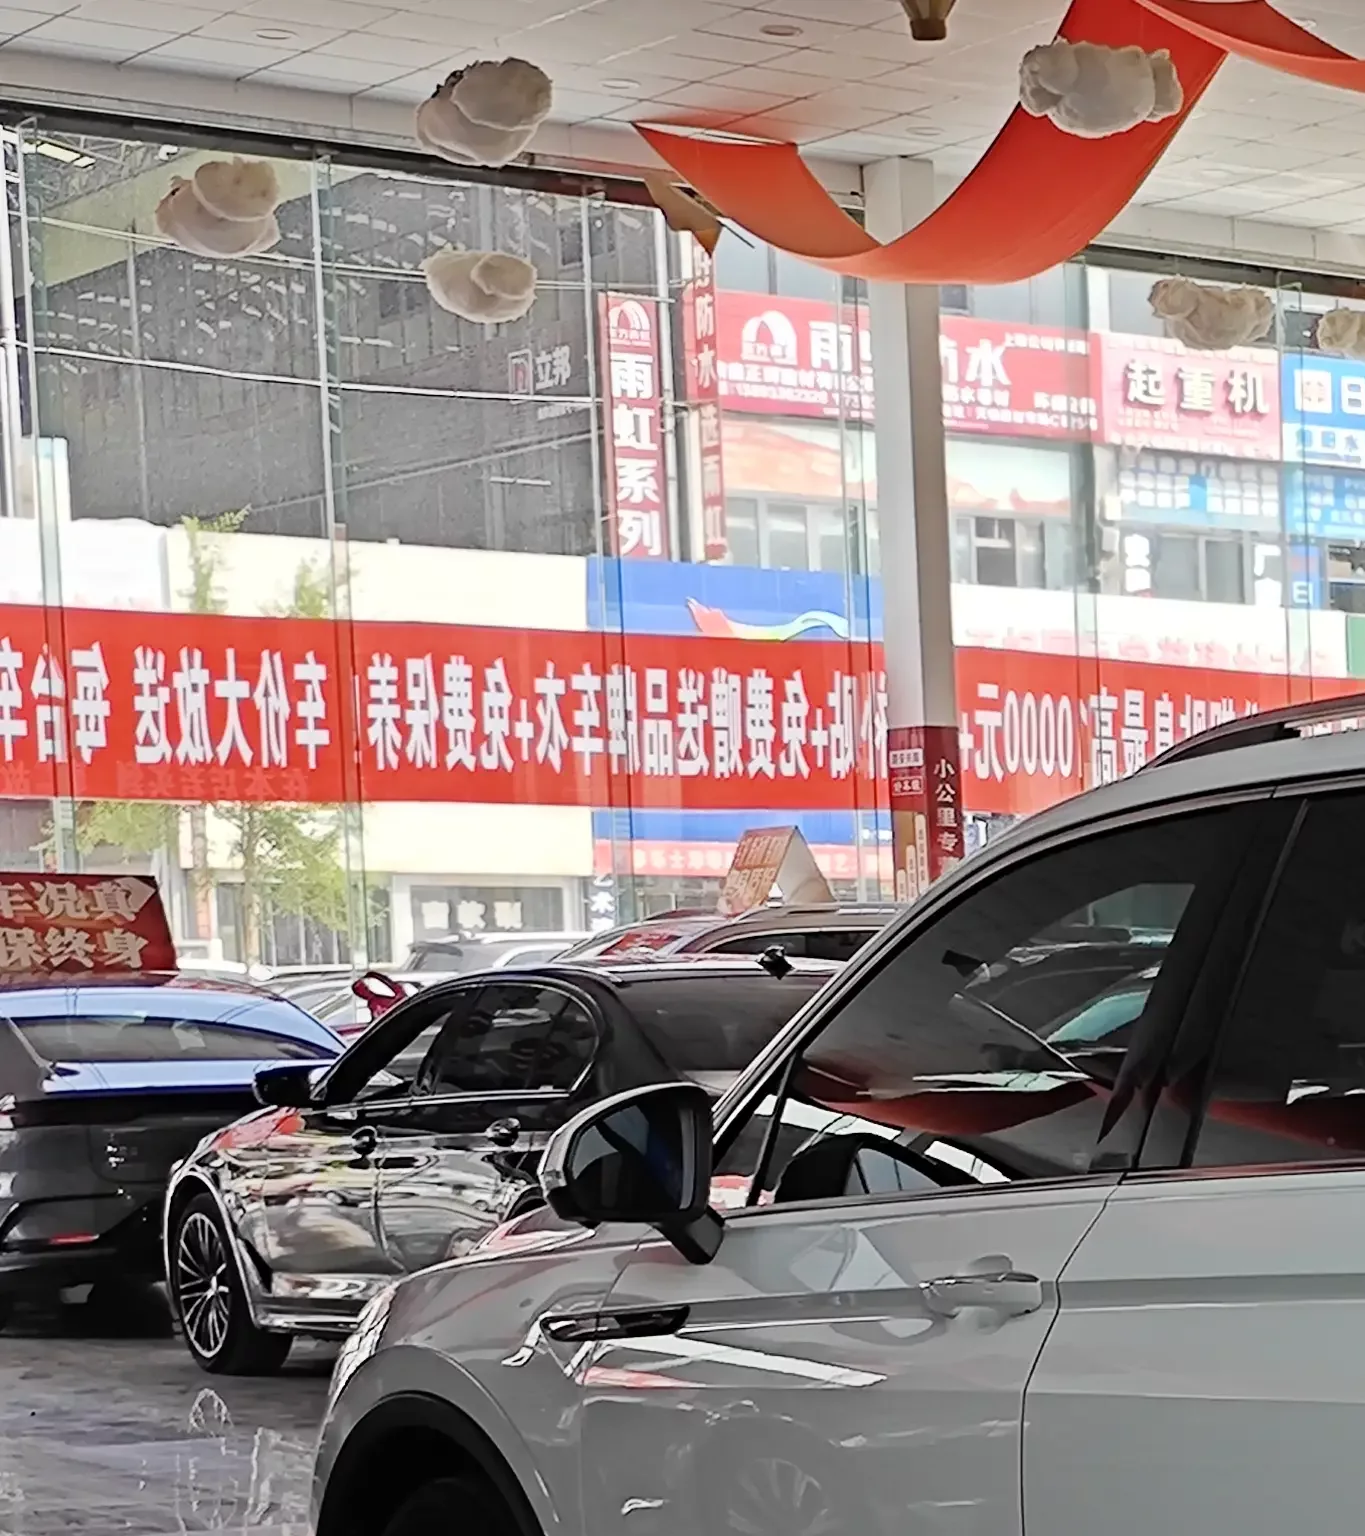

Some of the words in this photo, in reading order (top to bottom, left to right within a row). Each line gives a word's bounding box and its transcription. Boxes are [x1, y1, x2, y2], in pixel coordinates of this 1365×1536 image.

[535, 345, 571, 390] 立邦
[1126, 359, 1270, 416] 起重机
[608, 353, 662, 557] 雨虹系列
